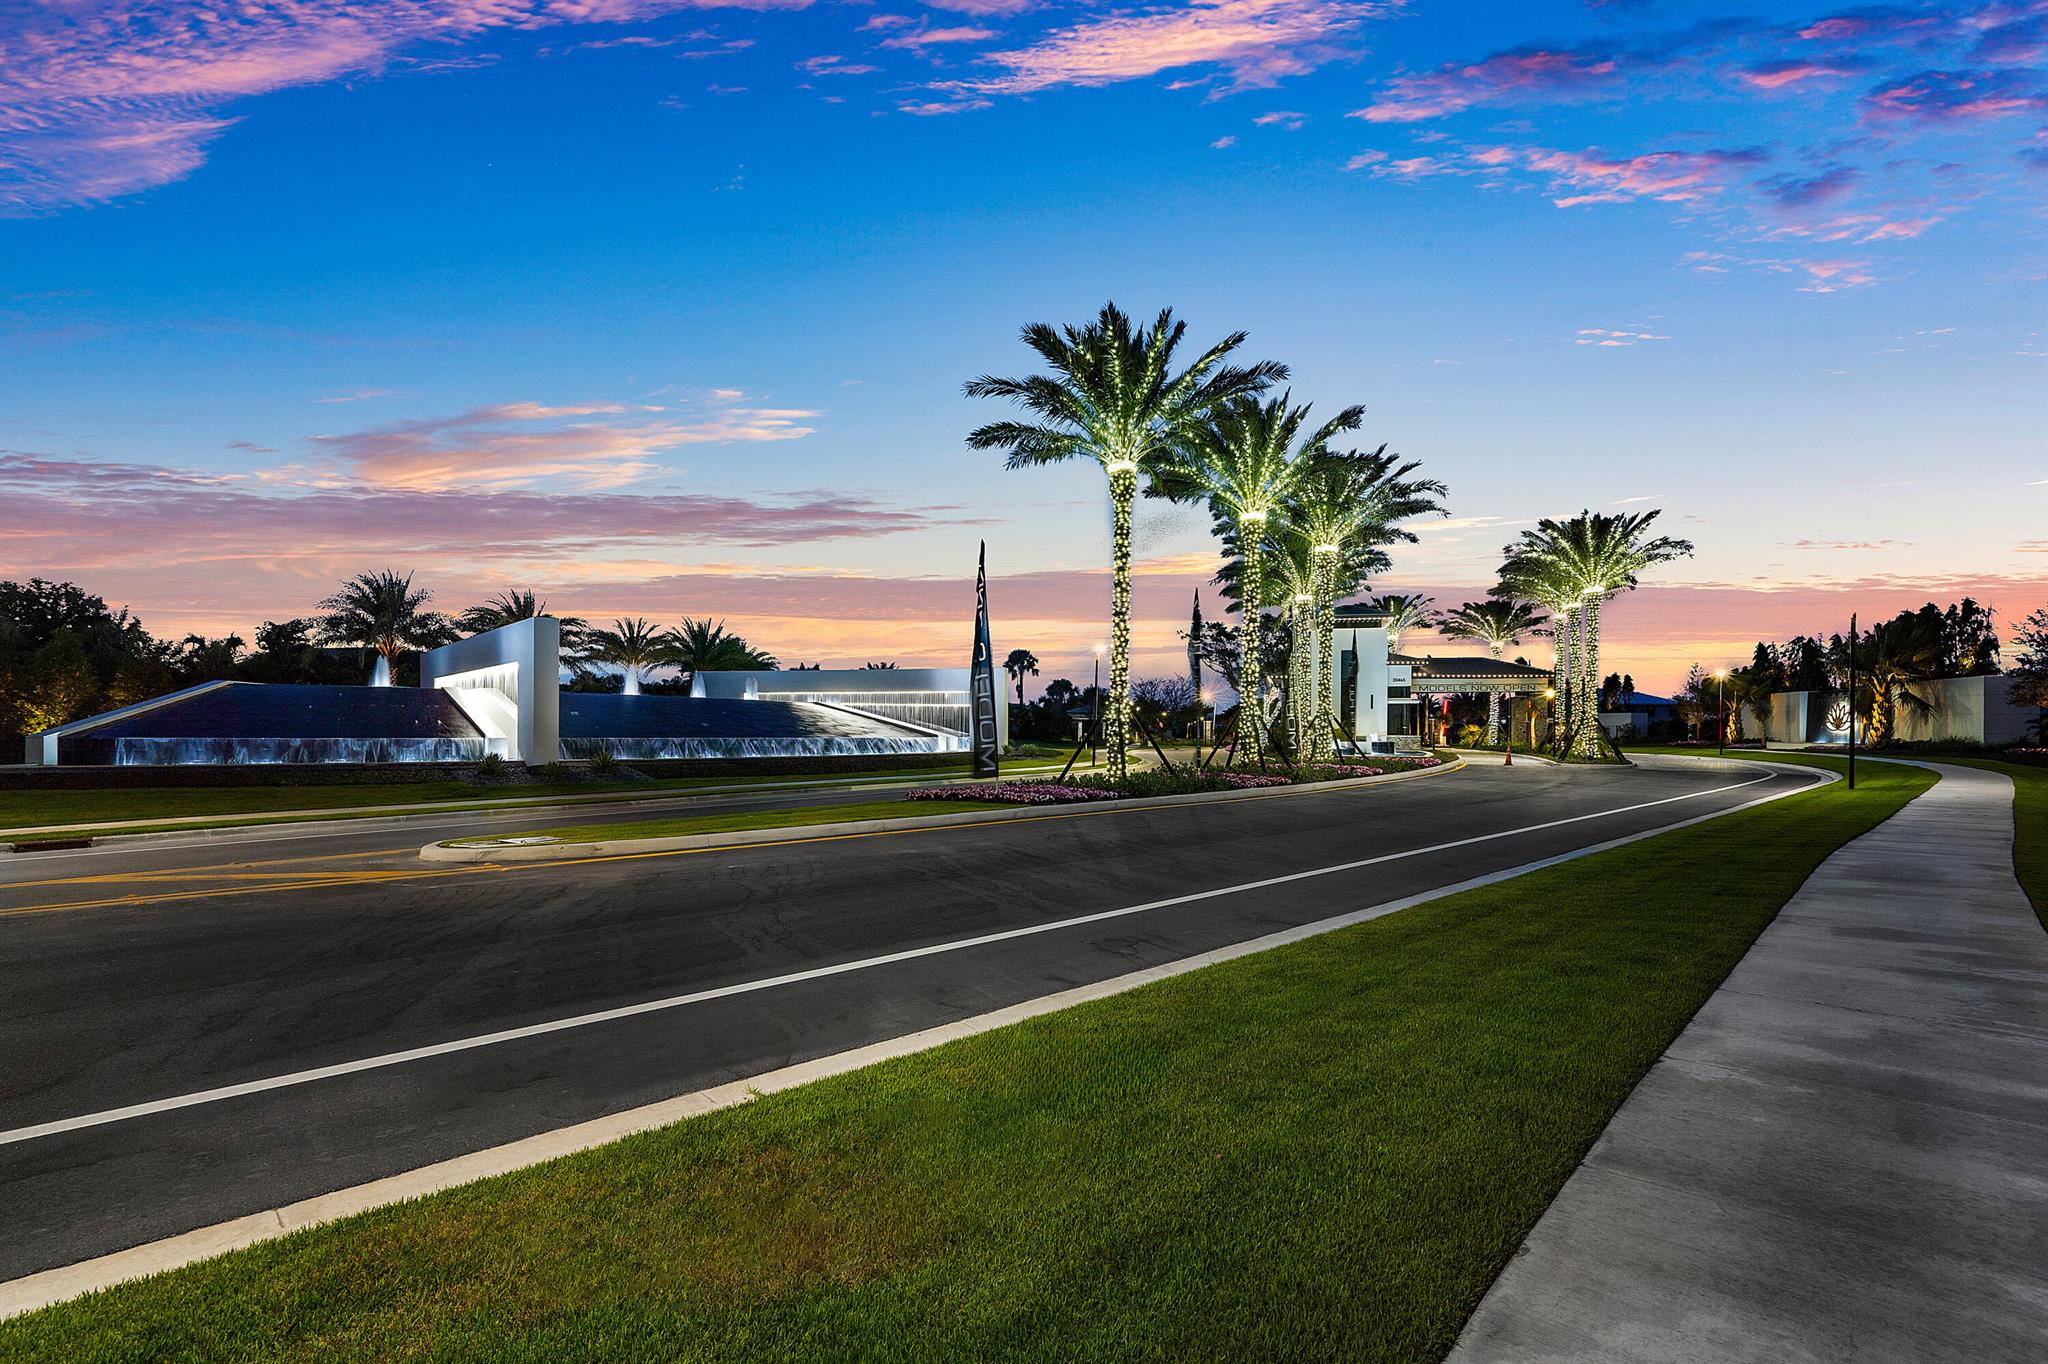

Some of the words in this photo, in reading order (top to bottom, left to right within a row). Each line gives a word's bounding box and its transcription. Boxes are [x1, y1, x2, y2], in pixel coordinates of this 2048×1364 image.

[1418, 684, 1467, 692] MODELS
[1471, 684, 1499, 692] NOW
[1504, 684, 1536, 692] OPEN
